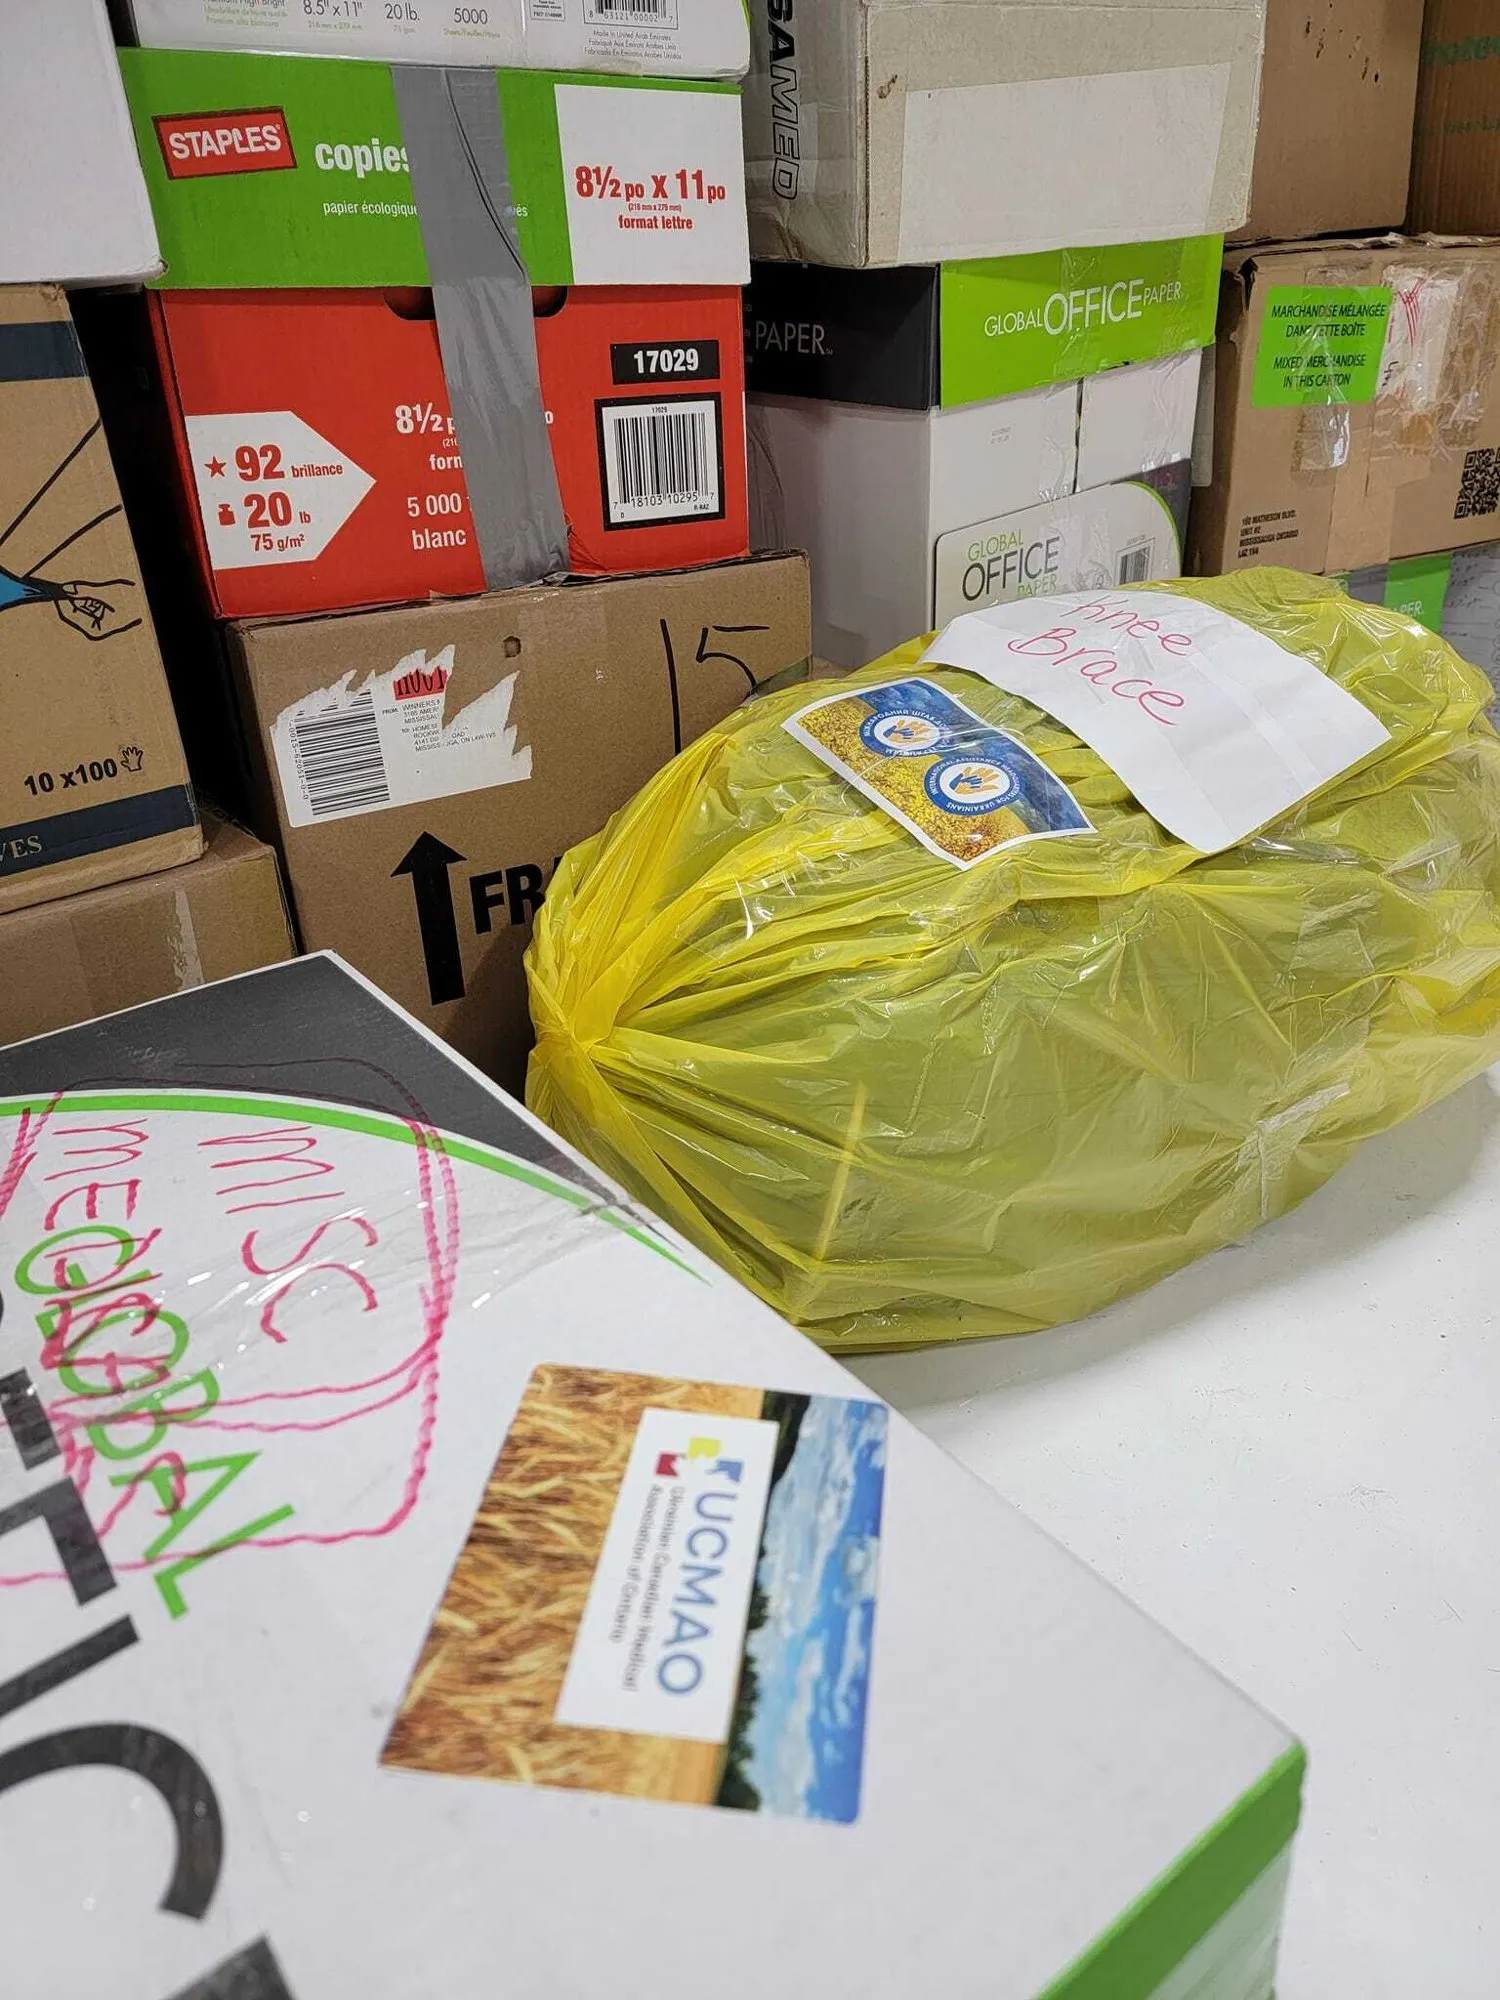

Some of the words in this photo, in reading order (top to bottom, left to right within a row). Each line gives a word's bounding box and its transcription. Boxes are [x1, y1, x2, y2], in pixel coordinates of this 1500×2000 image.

[384, 4, 403, 20] 20
[406, 4, 420, 21] lb.
[453, 8, 488, 25] 5000
[168, 125, 281, 160] STAPLES
[625, 182, 645, 202] po
[676, 169, 703, 199] 11
[707, 185, 726, 204] po
[323, 201, 359, 216] papier
[618, 215, 658, 229] format
[661, 215, 692, 229] lettre
[984, 308, 1043, 337] GLOBAL
[1043, 279, 1145, 336] OFFICE
[1143, 281, 1182, 306] PAPER
[1272, 304, 1339, 318] MARCHANDISE
[1339, 303, 1387, 317] MÉLANGÉE
[755, 320, 826, 355] PAPER
[1341, 321, 1367, 336] BOÎTE
[633, 348, 699, 374] 17029
[1273, 356, 1304, 369] MIXED
[1283, 376, 1293, 388] IN
[1295, 374, 1314, 387] THIS
[1314, 373, 1352, 386] CARTON
[544, 411, 554, 425] o
[235, 444, 285, 481] 92
[291, 463, 343, 479] brillance
[243, 491, 292, 529] 20
[299, 511, 311, 525] lb
[407, 496, 420, 518] 5
[425, 492, 462, 516] 000
[613, 502, 618, 510] 7
[630, 494, 663, 508] 18103
[668, 491, 698, 505] 10295
[710, 492, 715, 501] 7
[251, 534, 274, 552] 75
[411, 528, 467, 550] blanc
[967, 529, 1024, 562] GLOBAL
[962, 537, 1060, 601] OFFICE
[1016, 576, 1058, 597] PAPER
[1007, 627, 1184, 726] Brace
[402, 701, 435, 711] WINNERS
[419, 707, 439, 716] AMER
[24, 772, 54, 795] 10
[61, 758, 118, 788] x100
[469, 862, 547, 934] FR
[198, 1126, 378, 1343] MISC
[15, 1225, 295, 1620] GLOBAL
[657, 1491, 739, 1696] UCMAO
